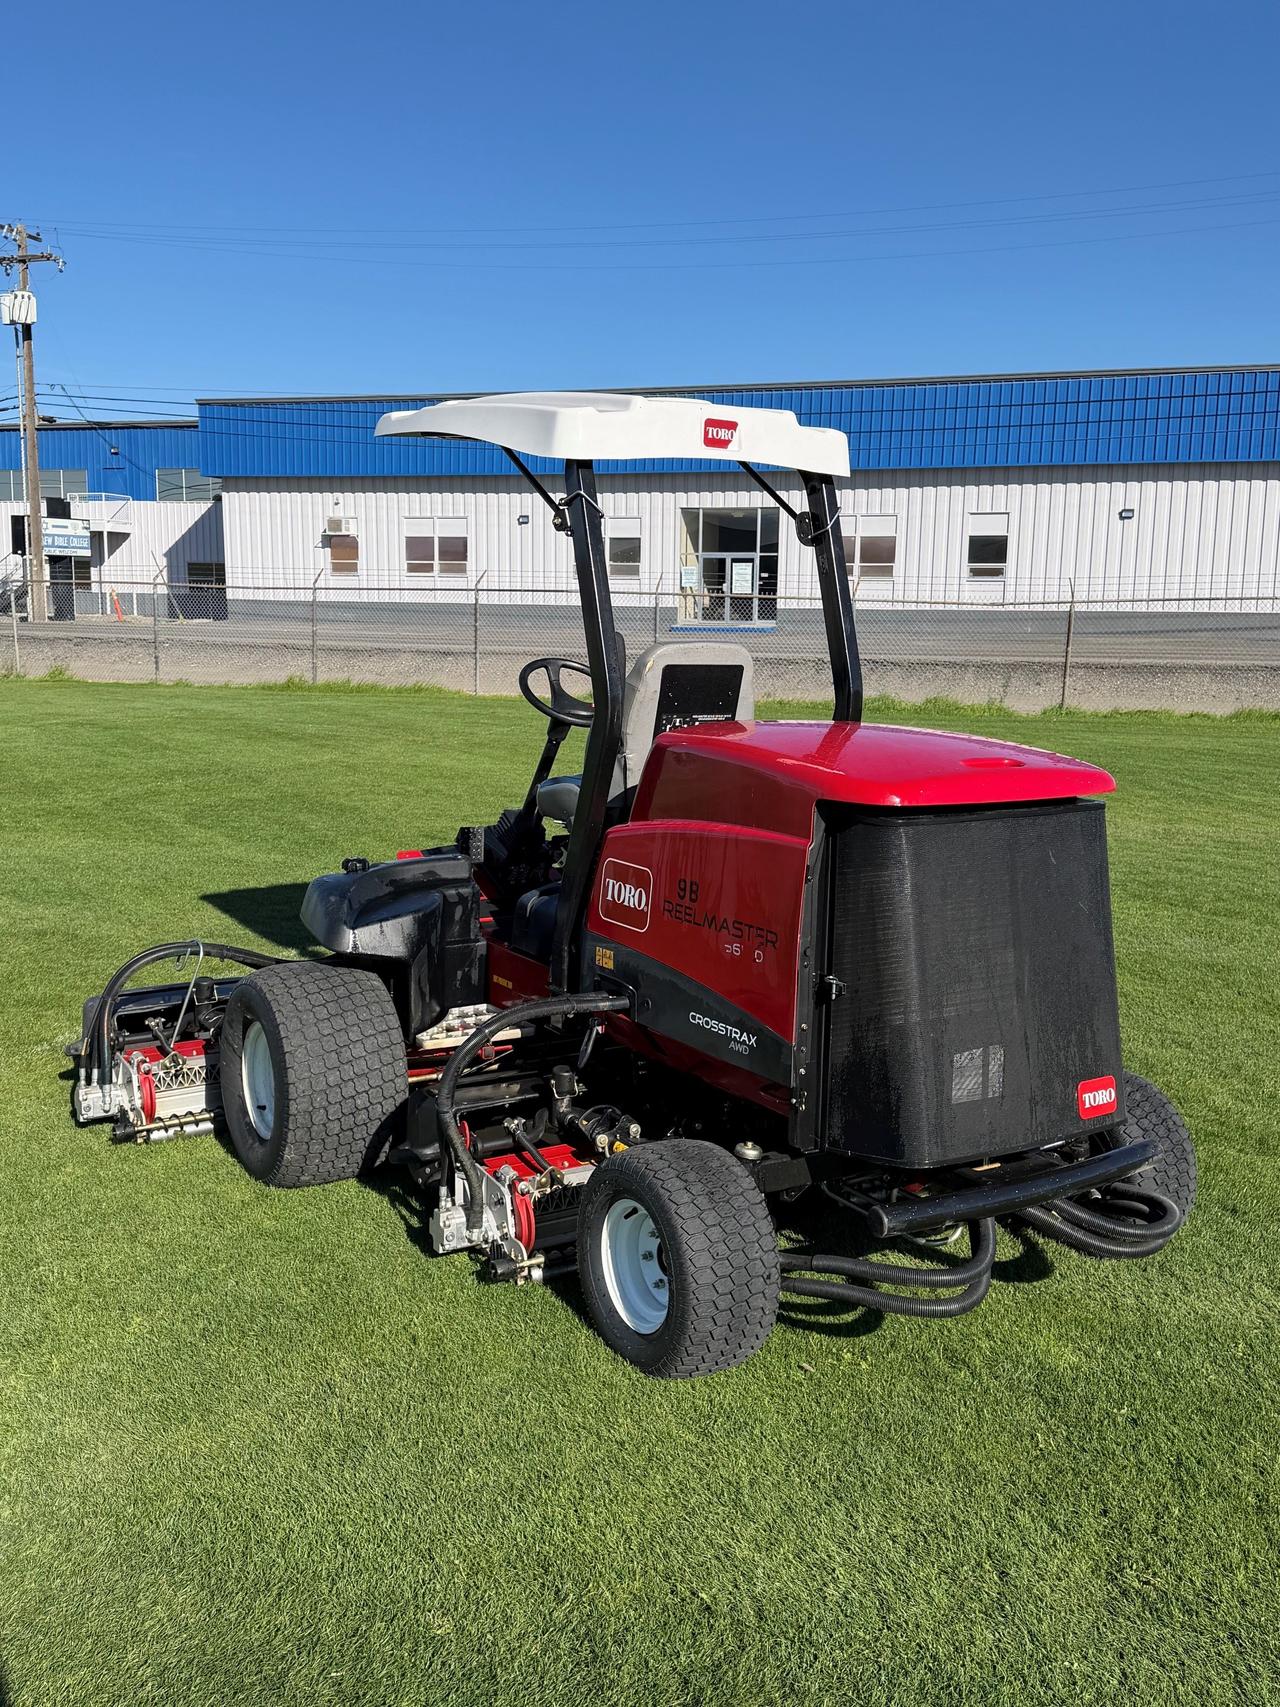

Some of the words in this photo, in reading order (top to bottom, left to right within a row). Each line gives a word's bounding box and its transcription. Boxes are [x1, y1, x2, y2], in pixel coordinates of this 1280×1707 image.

[706, 426, 736, 441] TORO
[54, 536, 69, 546] BIBLE
[69, 536, 89, 548] COLLEGE
[605, 878, 647, 911] TORO
[662, 899, 779, 950] REELMASTER
[689, 1011, 757, 1048] CROSSTRAX
[728, 1040, 749, 1055] AWD
[1082, 1087, 1116, 1109] TORO
